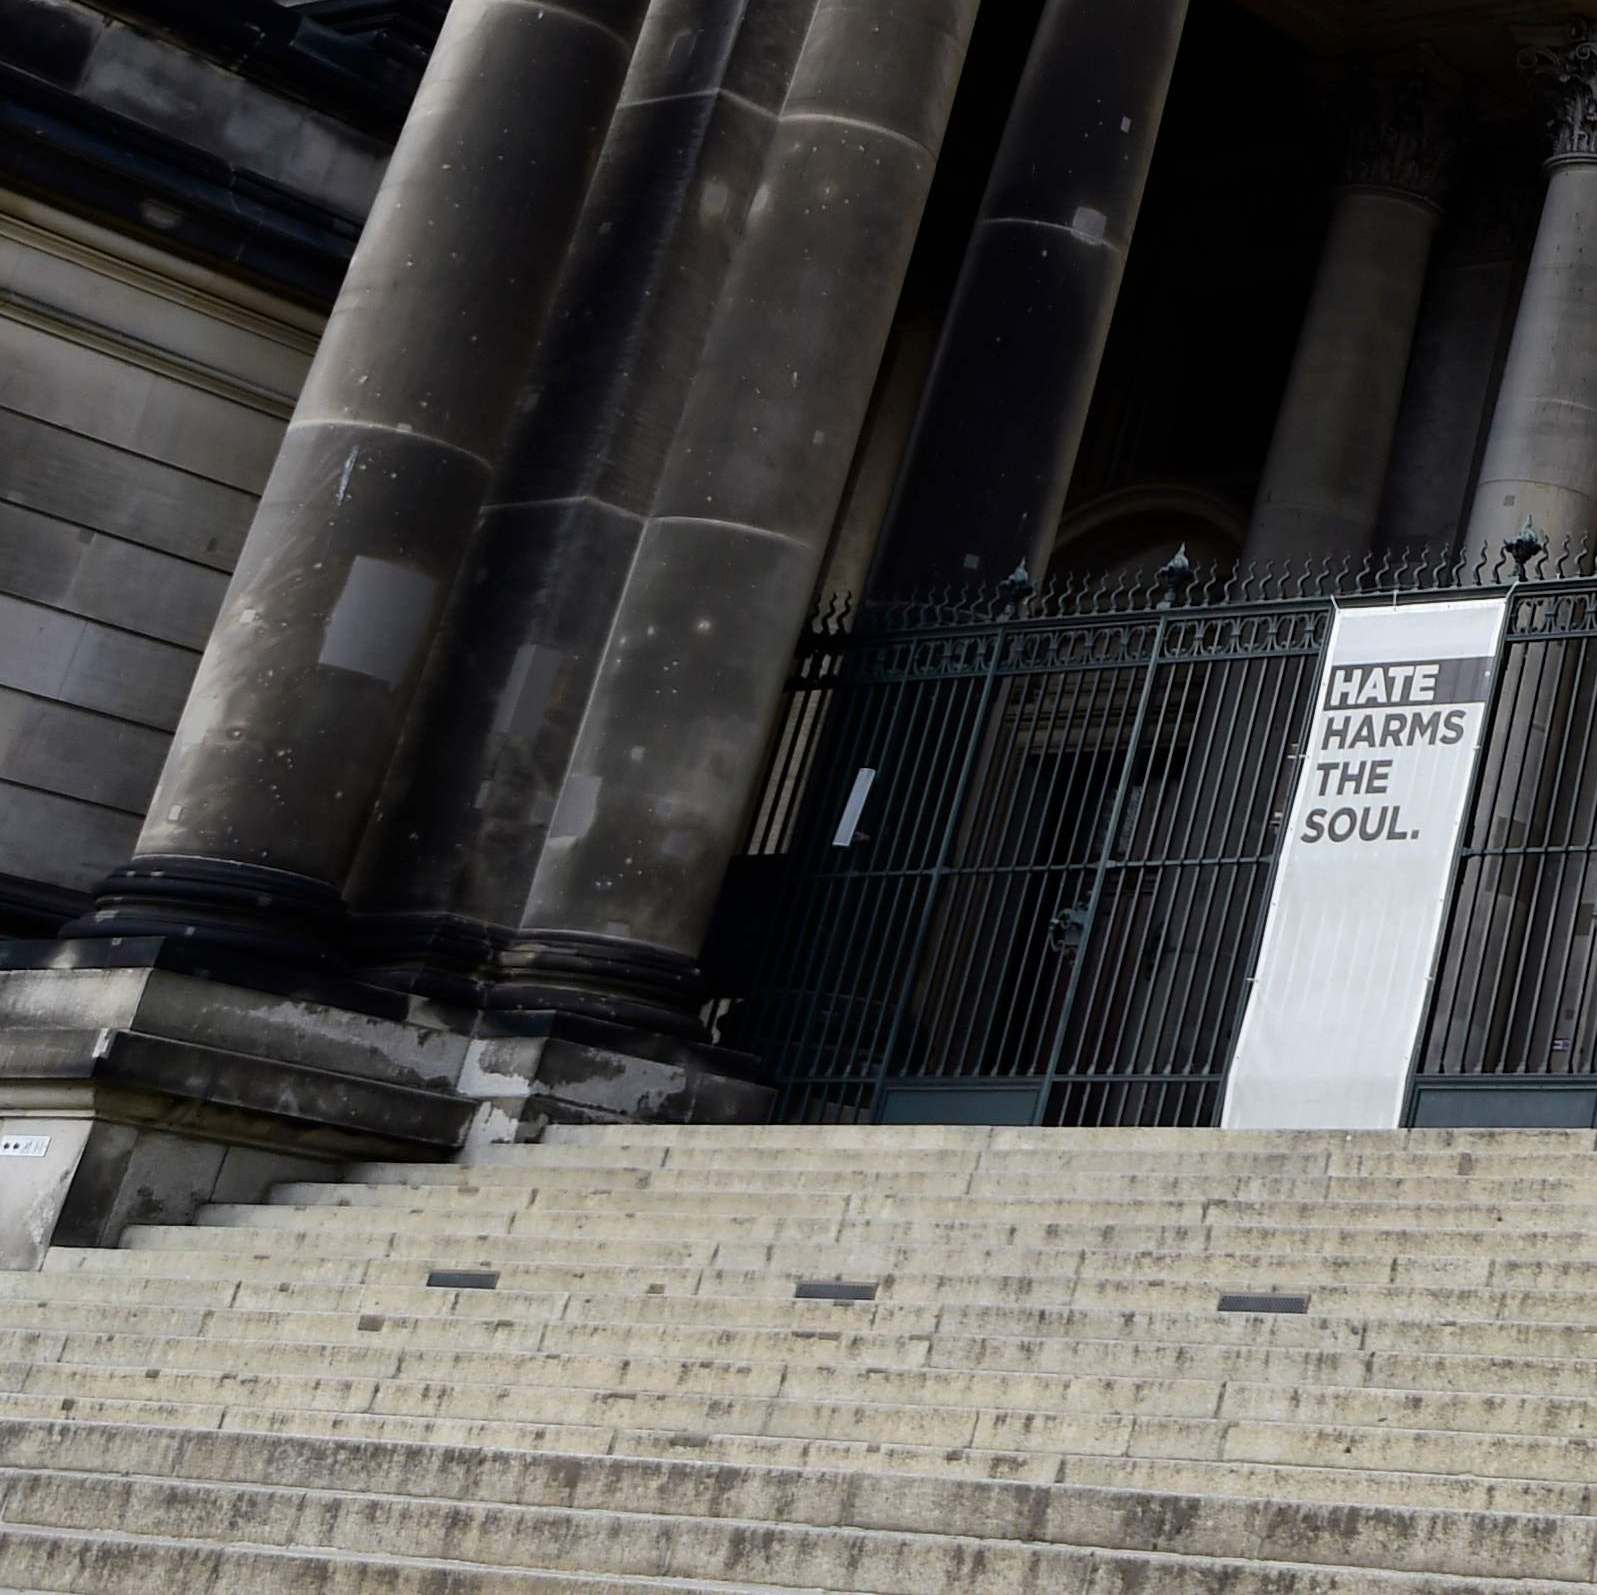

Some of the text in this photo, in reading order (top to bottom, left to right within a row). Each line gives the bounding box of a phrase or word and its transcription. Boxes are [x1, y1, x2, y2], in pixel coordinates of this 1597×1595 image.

[1330, 664, 1440, 706] HATE
[1321, 710, 1466, 750] HARMS
[1317, 760, 1393, 796] THE
[1300, 806, 1420, 843] SOUL.
